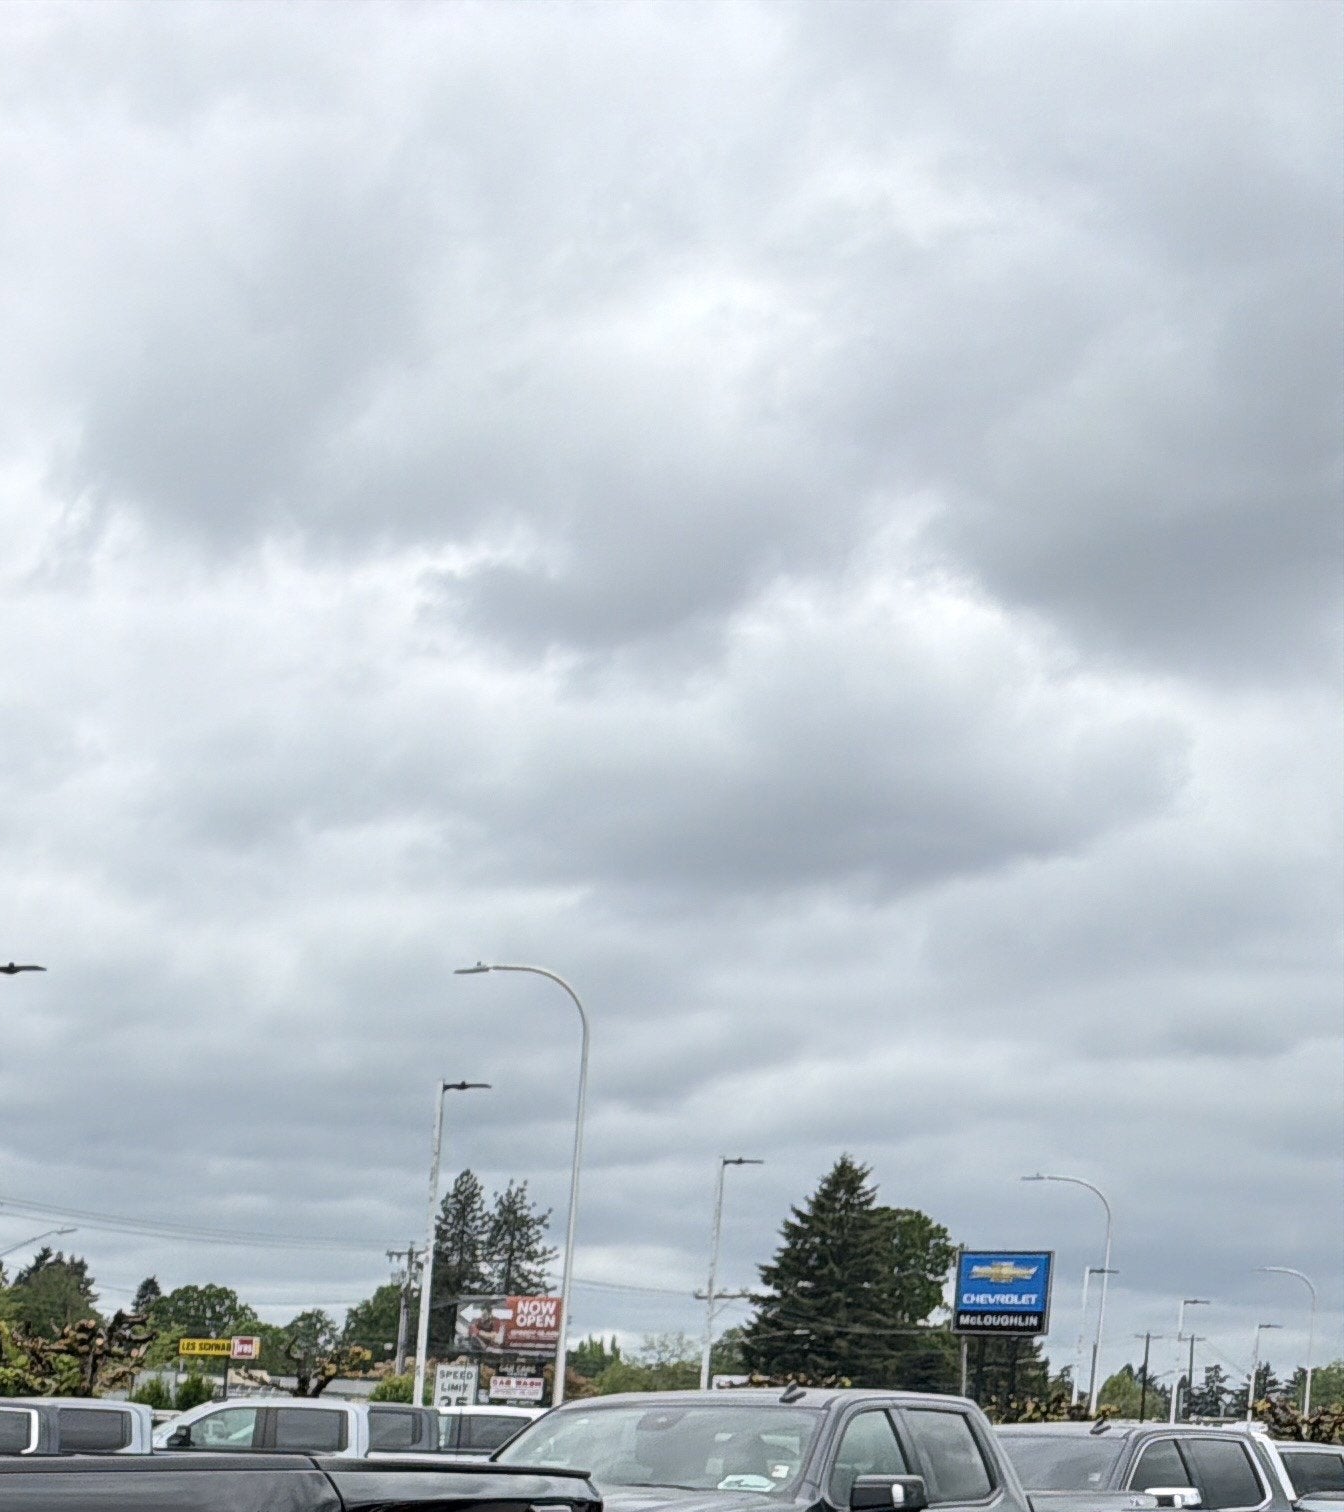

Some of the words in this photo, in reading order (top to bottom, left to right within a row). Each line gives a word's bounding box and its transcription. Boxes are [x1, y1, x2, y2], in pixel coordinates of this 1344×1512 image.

[962, 1293, 1038, 1305] CHEVROLET
[517, 1300, 557, 1315] NOW
[516, 1315, 556, 1328] OPEN
[959, 1314, 1039, 1326] McLOUGHLIN
[439, 1369, 473, 1380] SPEED
[440, 1382, 468, 1393] LIMIT
